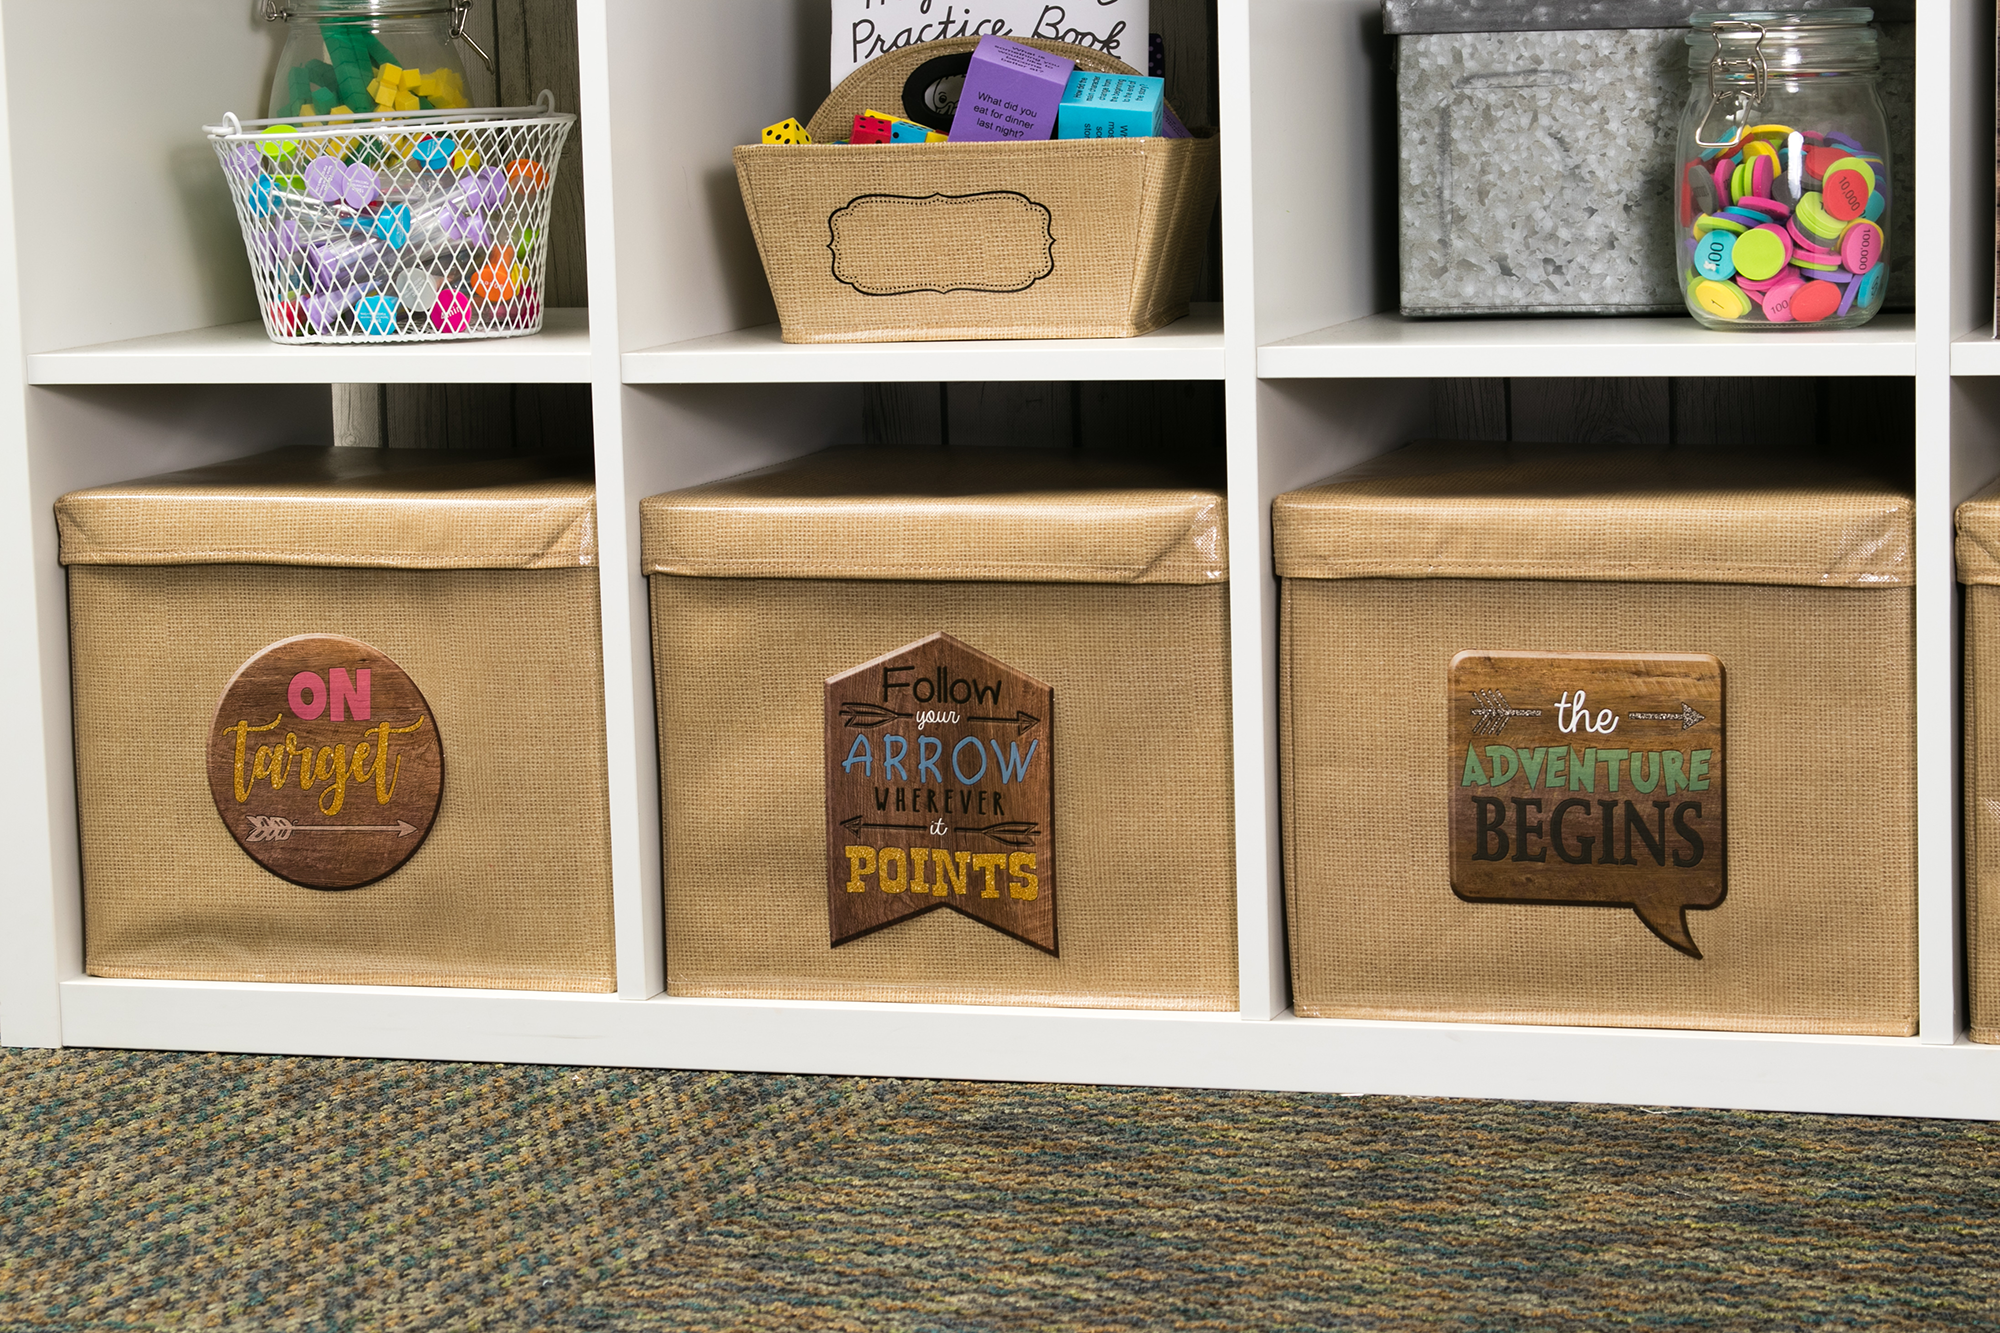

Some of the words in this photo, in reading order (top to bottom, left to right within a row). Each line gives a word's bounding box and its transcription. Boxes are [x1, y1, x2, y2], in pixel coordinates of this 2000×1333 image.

[852, 5, 1013, 63] Practice
[1032, 4, 1128, 60] Book
[973, 105, 989, 115] eat
[990, 108, 1004, 120] for
[1005, 115, 1034, 129] dinner
[978, 92, 1002, 106] What
[1003, 101, 1019, 112] did
[1020, 107, 1037, 118] you
[976, 118, 994, 130] last
[995, 125, 1025, 138] night?
[1838, 176, 1861, 212] 10,000
[1858, 229, 1871, 271] 100,000
[287, 667, 371, 722] ON
[883, 666, 1002, 705] Follow
[916, 709, 960, 730] your
[1554, 690, 1619, 734] the
[842, 733, 1038, 785] ARROW
[1461, 741, 1712, 796] ADVENTURE
[874, 786, 1005, 816] WHEREVER
[930, 817, 948, 836] it
[1471, 796, 1705, 868] BEGINS
[845, 845, 1039, 900] POINTS
